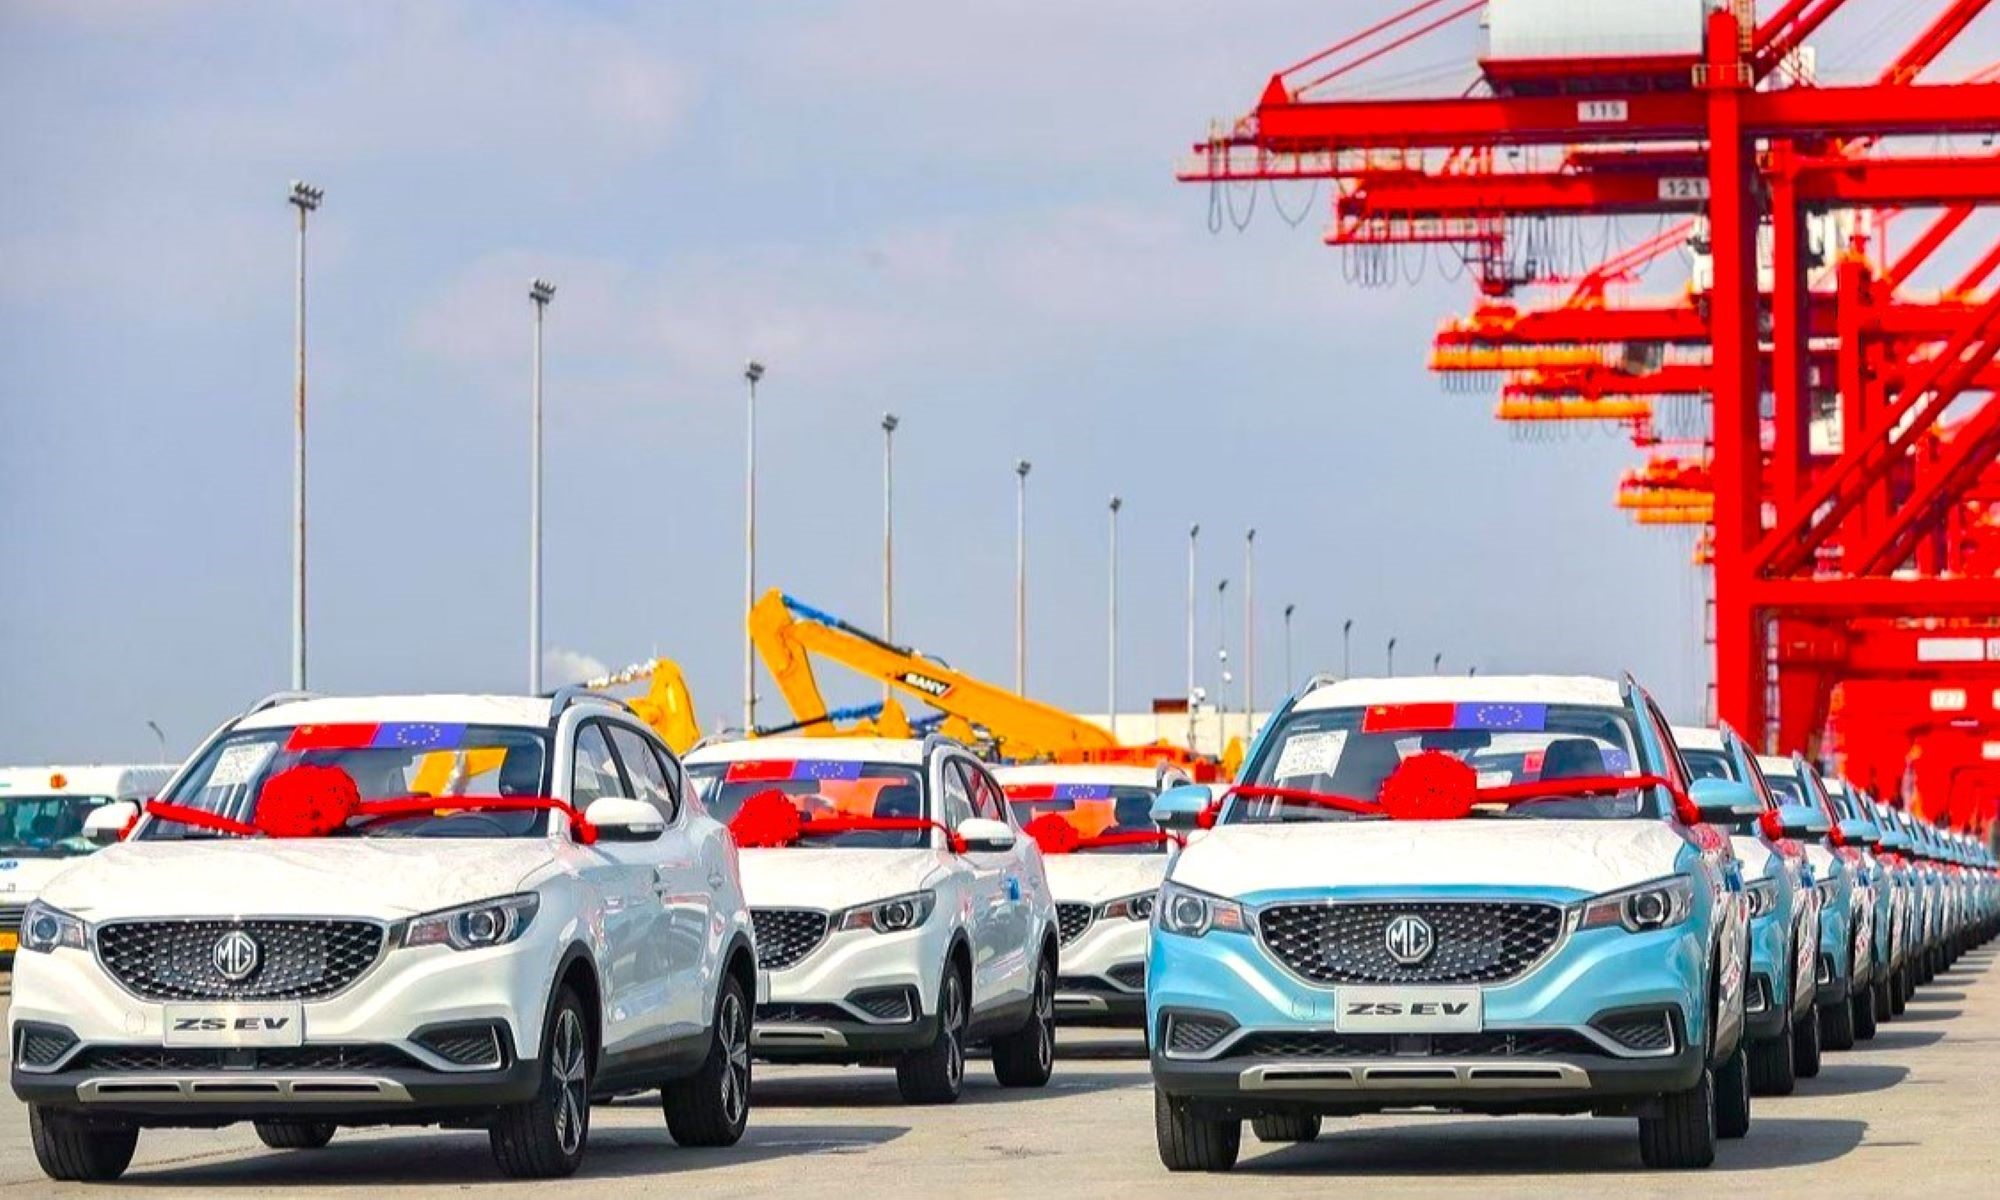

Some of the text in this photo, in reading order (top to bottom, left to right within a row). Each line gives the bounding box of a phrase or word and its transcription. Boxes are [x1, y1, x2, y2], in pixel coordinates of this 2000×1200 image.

[1589, 102, 1621, 118] 115
[1667, 180, 1702, 197] 121
[1390, 919, 1426, 957] MG
[217, 937, 251, 974] MG
[1346, 1003, 1469, 1016] ZS EV
[173, 1017, 290, 1031] ZS EV
